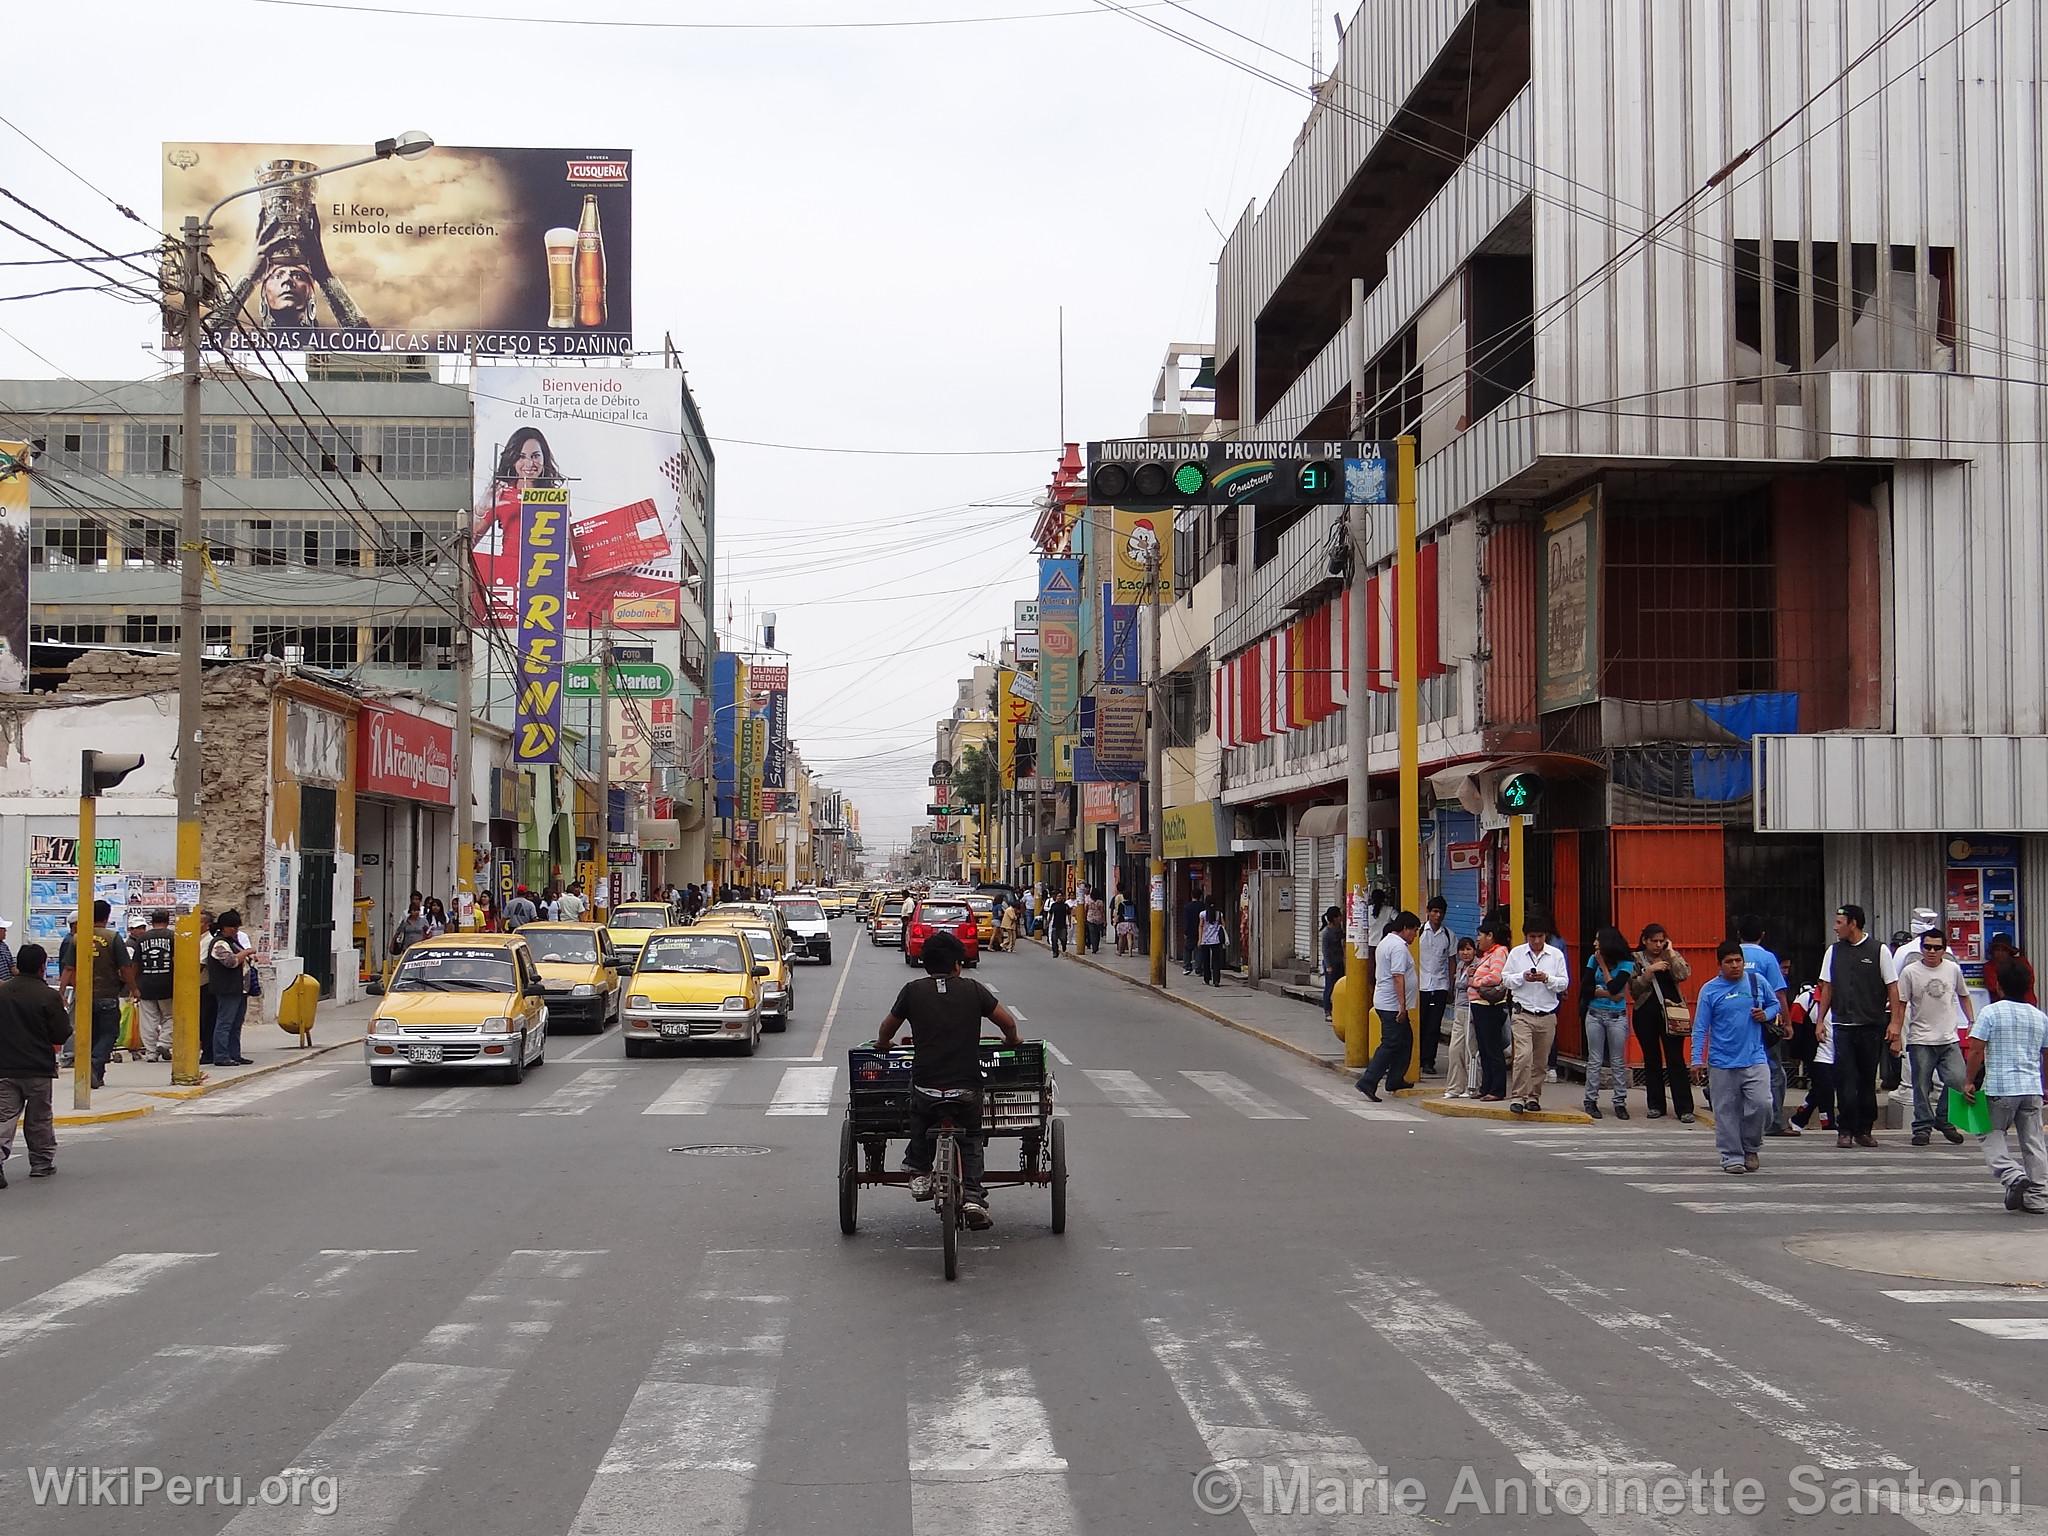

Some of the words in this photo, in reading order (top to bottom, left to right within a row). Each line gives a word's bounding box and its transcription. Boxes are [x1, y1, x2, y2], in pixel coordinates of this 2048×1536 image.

[573, 165, 623, 179] CUSQUEÑA
[333, 203, 345, 216] El
[351, 204, 389, 218] Kero,
[395, 222, 413, 234] de
[418, 223, 499, 237] perfección.
[230, 331, 300, 350] BEBIDAS
[308, 329, 429, 351] ALCOHÓLICAS
[437, 334, 458, 351] EN
[466, 335, 531, 352] EXCESO
[538, 336, 556, 352] ES
[564, 334, 630, 353] DAÑINO
[542, 378, 622, 392] Bienvenido
[520, 396, 526, 405] a
[530, 394, 539, 405] la
[543, 395, 581, 408] Tarjeta
[584, 394, 598, 406] de
[601, 395, 640, 407] Débito
[514, 407, 529, 419] de
[531, 408, 541, 419] la
[544, 409, 569, 421] Caja
[572, 409, 629, 422] Municipal
[632, 410, 648, 420] Ica
[1101, 442, 1209, 460] MUNICIPALIDAD
[1225, 442, 1311, 460] PROVINCIAL
[1324, 442, 1342, 459] DE
[1358, 442, 1381, 459] ICA
[1228, 470, 1274, 499] Construye
[523, 490, 568, 503] BOTICAS
[616, 608, 660, 620] globalnet
[518, 511, 561, 759] EFREND
[622, 650, 640, 659] FOTO
[568, 673, 590, 689] ica
[616, 673, 662, 690] Market
[771, 694, 783, 750] Nazareno
[384, 728, 426, 789] Arcángel
[938, 788, 946, 832] COON
